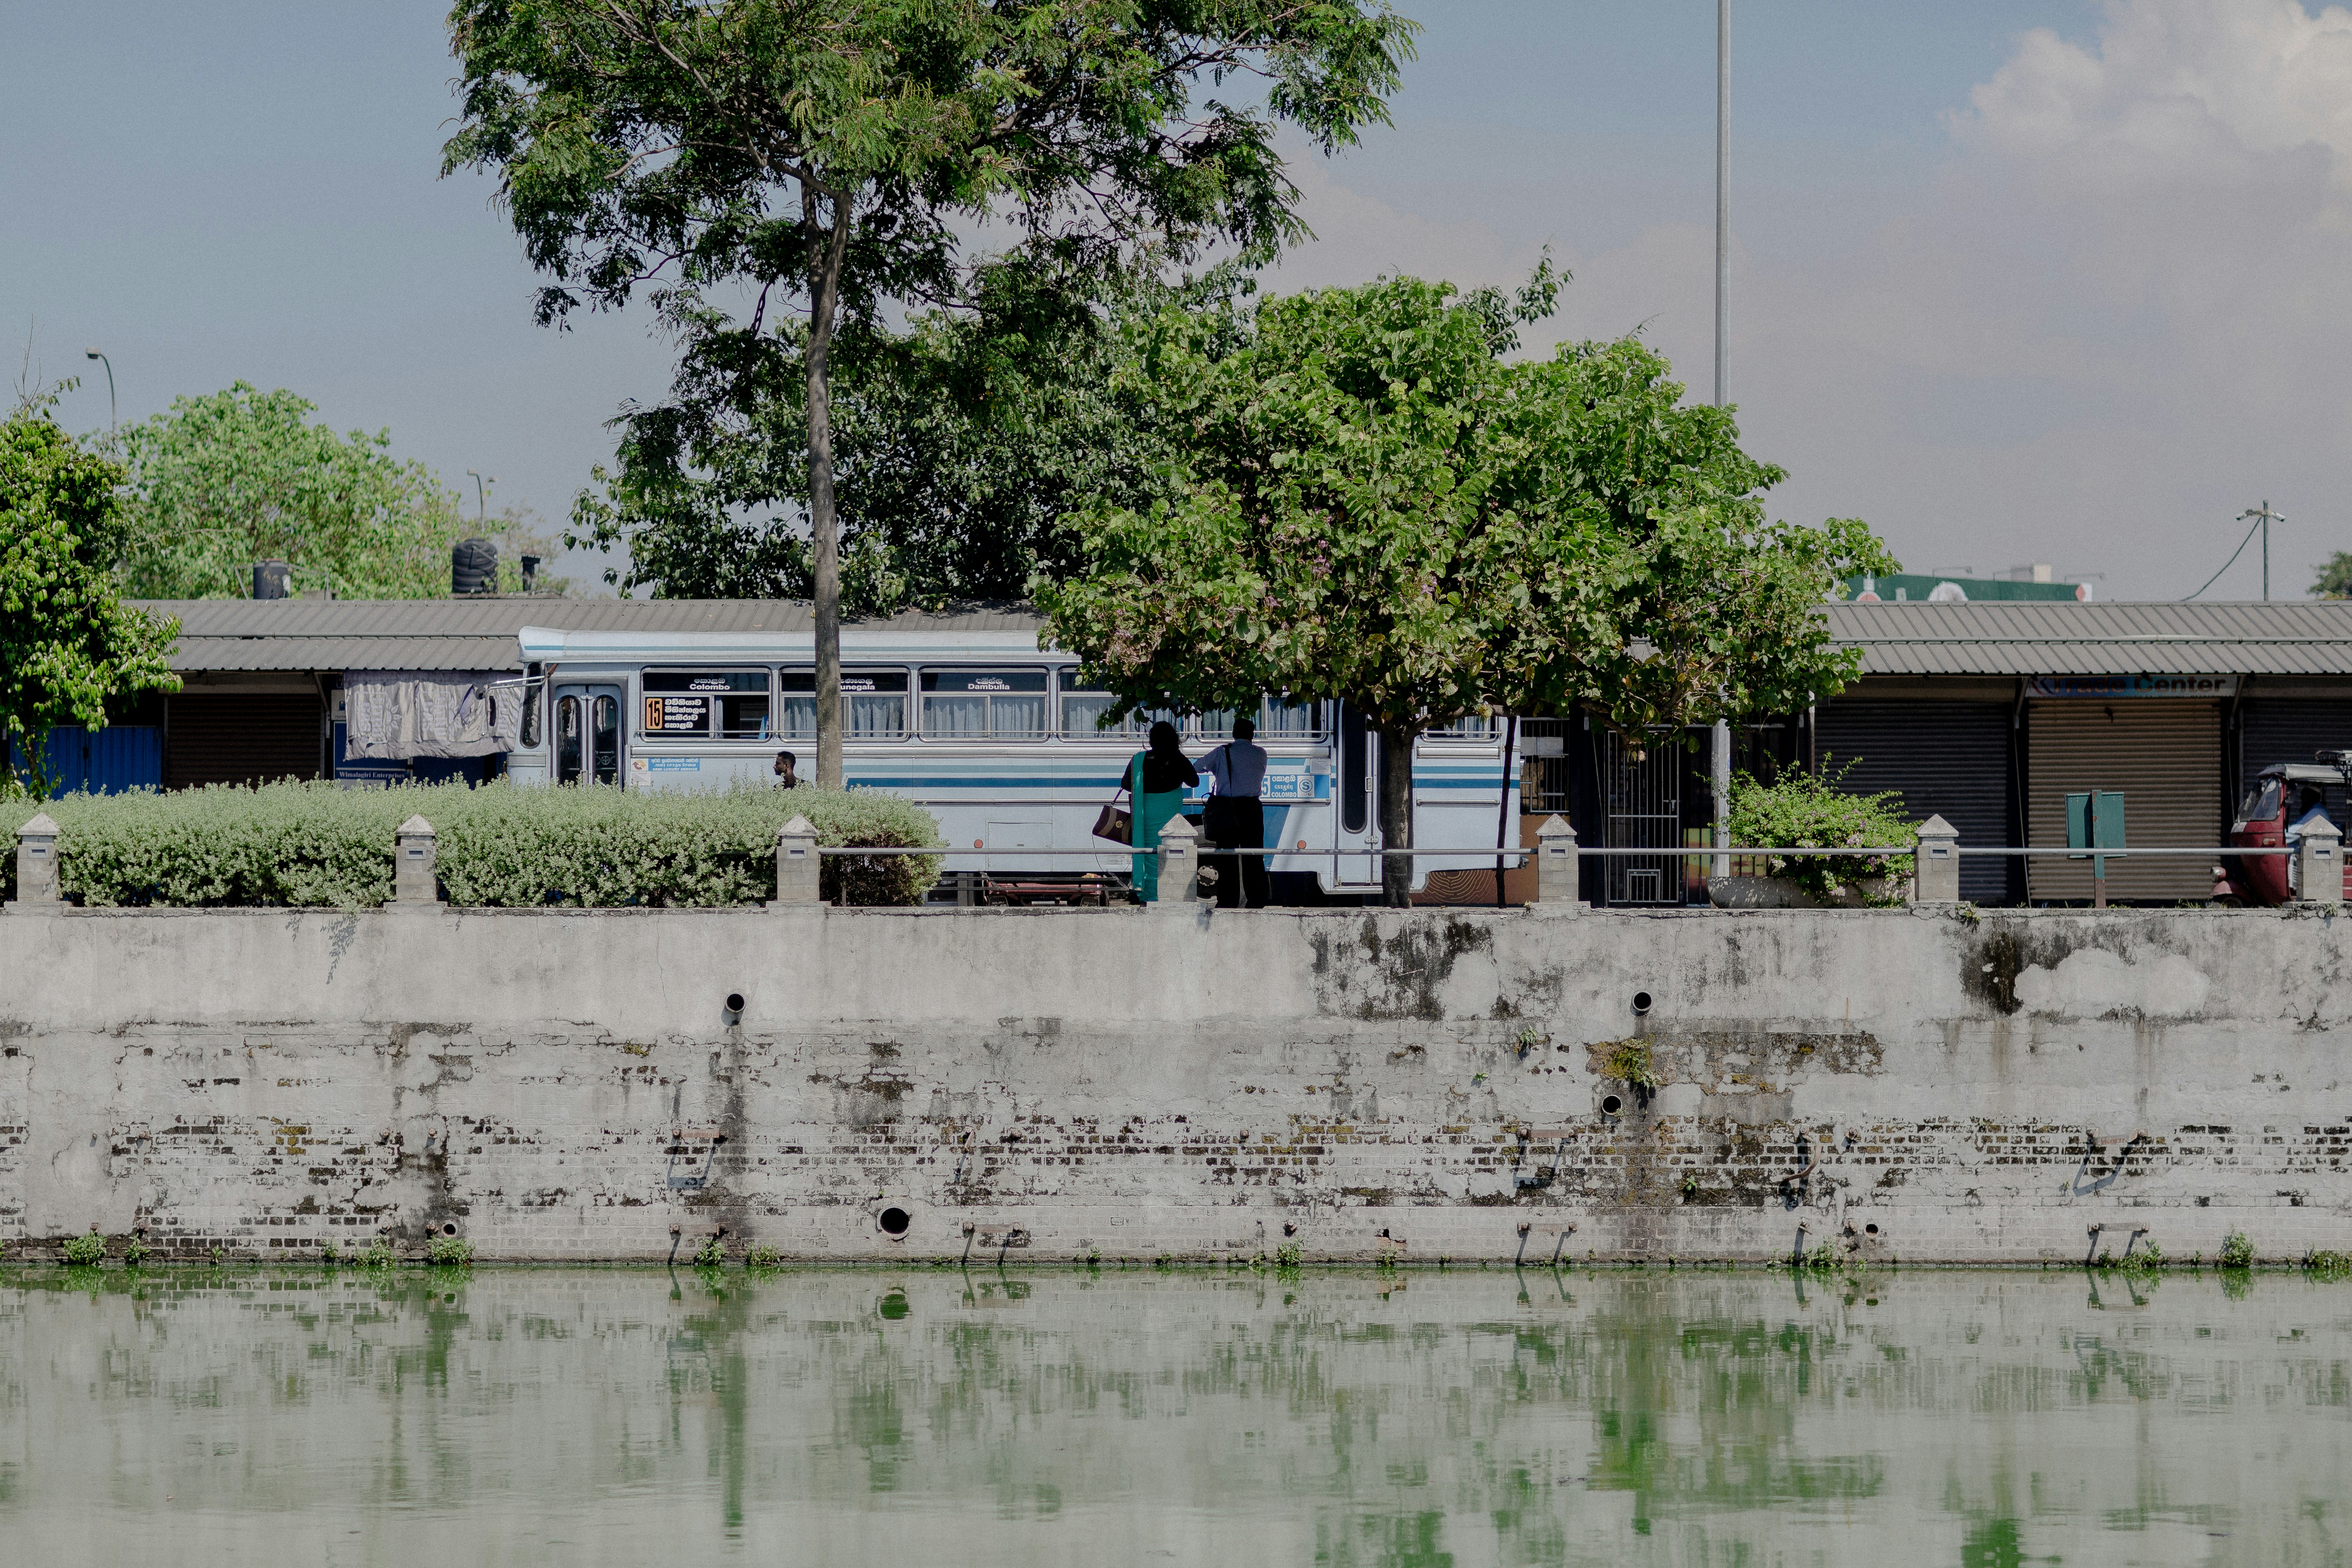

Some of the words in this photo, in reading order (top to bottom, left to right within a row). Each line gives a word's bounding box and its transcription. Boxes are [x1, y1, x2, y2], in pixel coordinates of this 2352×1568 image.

[2051, 676, 2126, 693] Trade
[2134, 675, 2226, 692] Center
[648, 700, 660, 726] 15
[1262, 778, 1268, 795] 5
